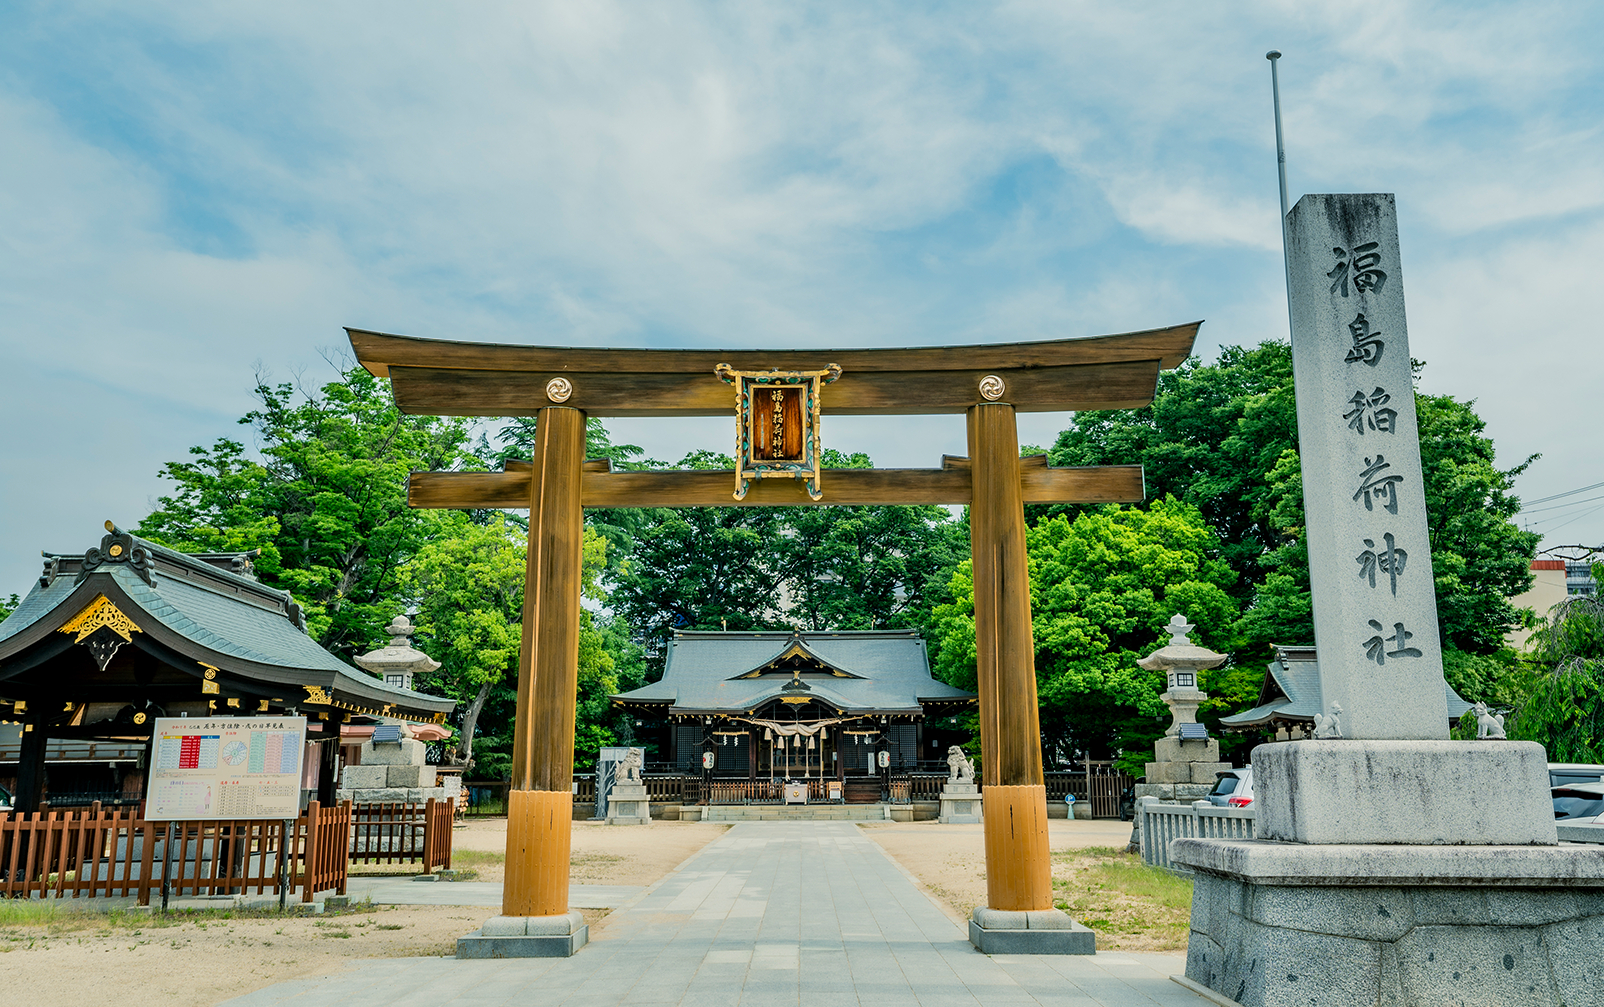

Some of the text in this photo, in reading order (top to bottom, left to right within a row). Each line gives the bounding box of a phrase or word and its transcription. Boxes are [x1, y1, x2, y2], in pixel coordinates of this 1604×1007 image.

[771, 389, 784, 458] 福島稲荷神社
[1327, 242, 1423, 665] 福島稲荷神社
